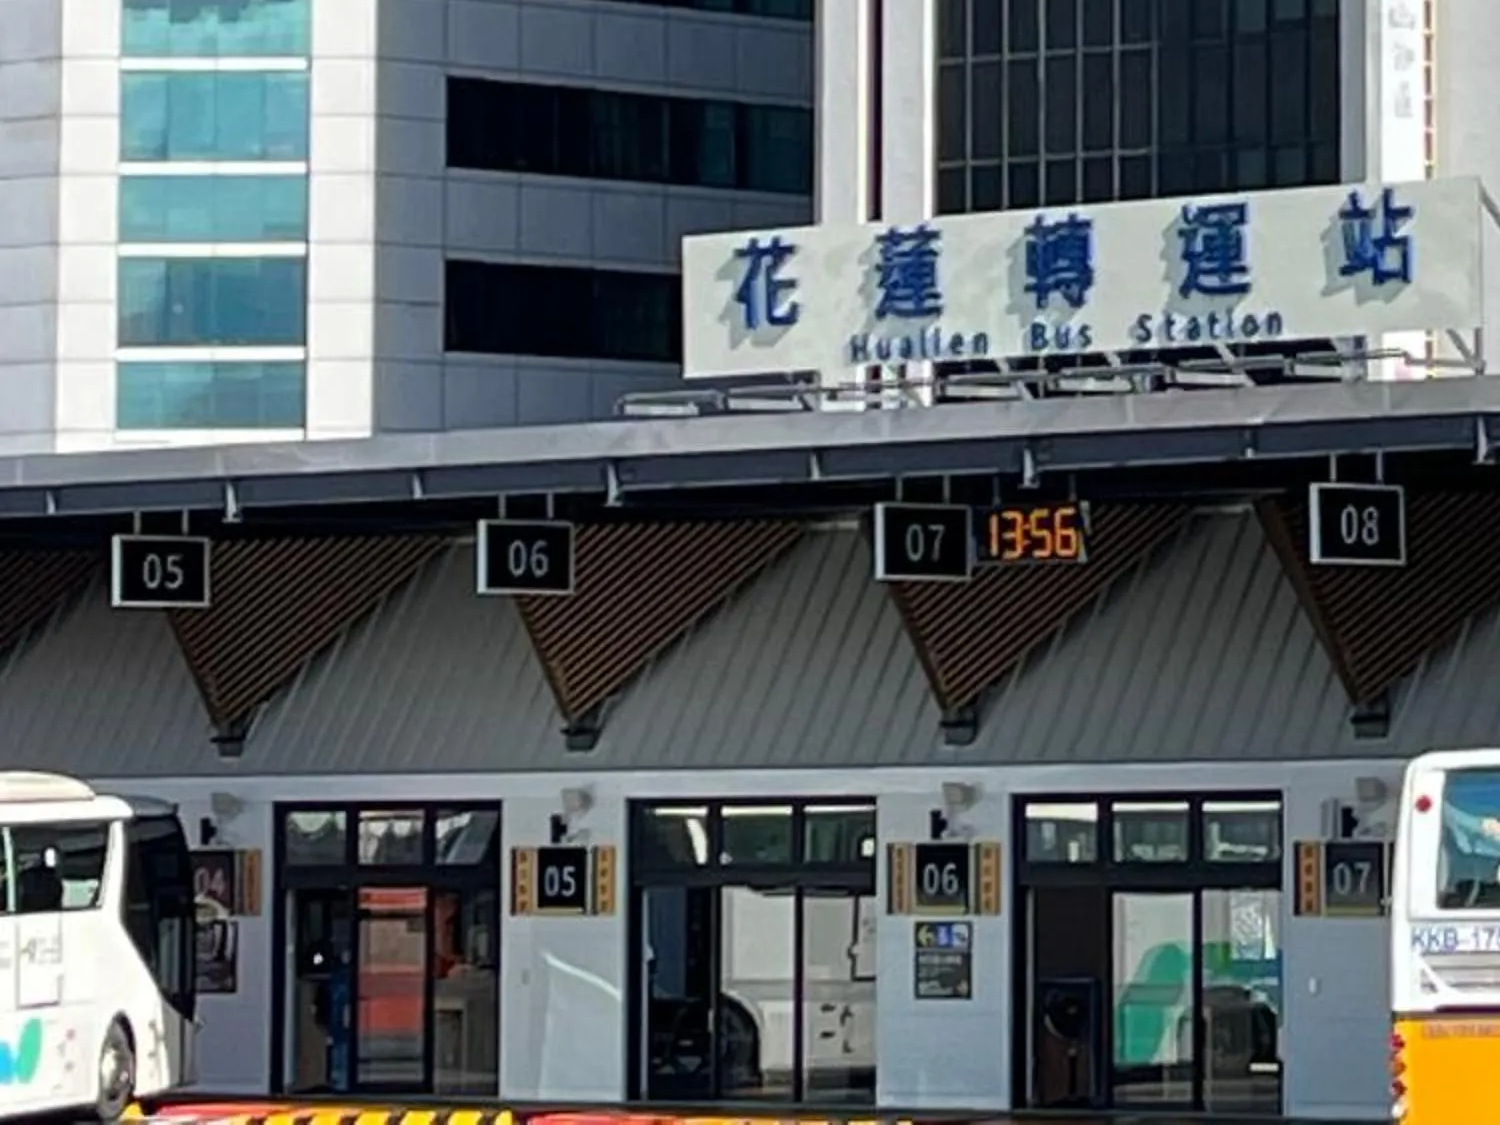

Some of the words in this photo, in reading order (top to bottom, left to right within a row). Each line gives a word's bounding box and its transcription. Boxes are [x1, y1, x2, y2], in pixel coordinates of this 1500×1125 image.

[733, 188, 1415, 330] 花蓮轉運站
[848, 330, 991, 363] Hualien
[1030, 323, 1093, 352] Bus
[1135, 309, 1285, 345] Station
[905, 524, 946, 562] 07
[988, 507, 1078, 560] 13:56
[1340, 504, 1380, 545] 08
[142, 554, 185, 590] 05
[508, 539, 550, 578] 06
[544, 864, 577, 898] 05
[923, 862, 960, 896] 06
[1333, 862, 1372, 896] 07
